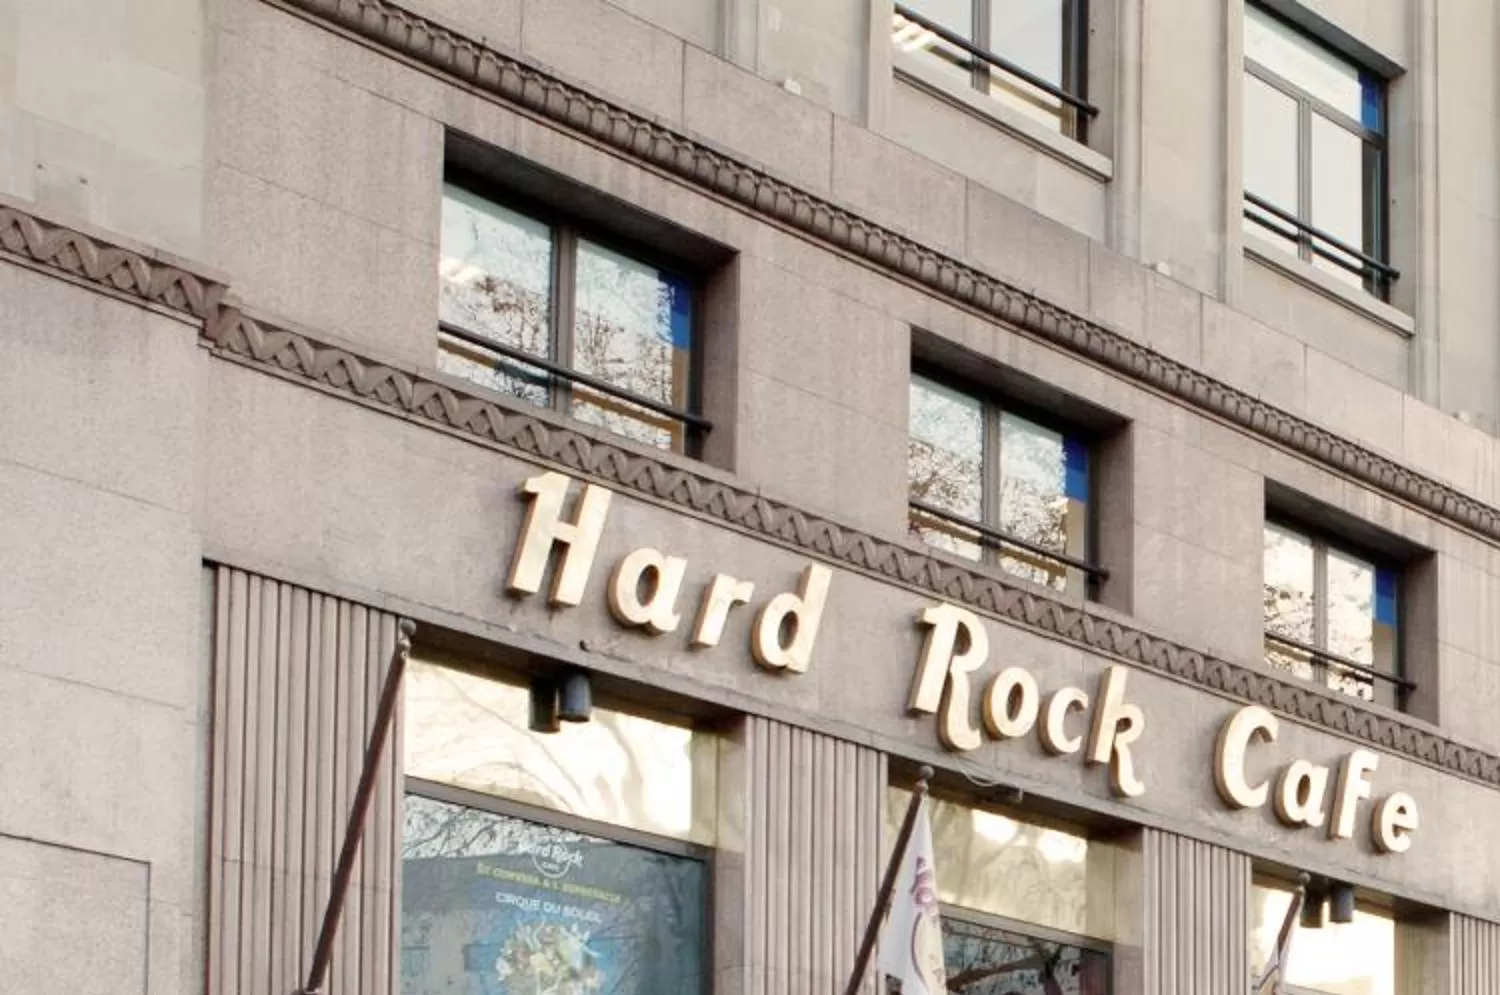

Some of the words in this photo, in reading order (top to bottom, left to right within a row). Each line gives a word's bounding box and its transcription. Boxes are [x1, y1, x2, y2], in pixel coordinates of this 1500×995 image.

[506, 471, 833, 675] Hard
[907, 602, 1145, 798] Rock
[1214, 705, 1420, 854] Cafe
